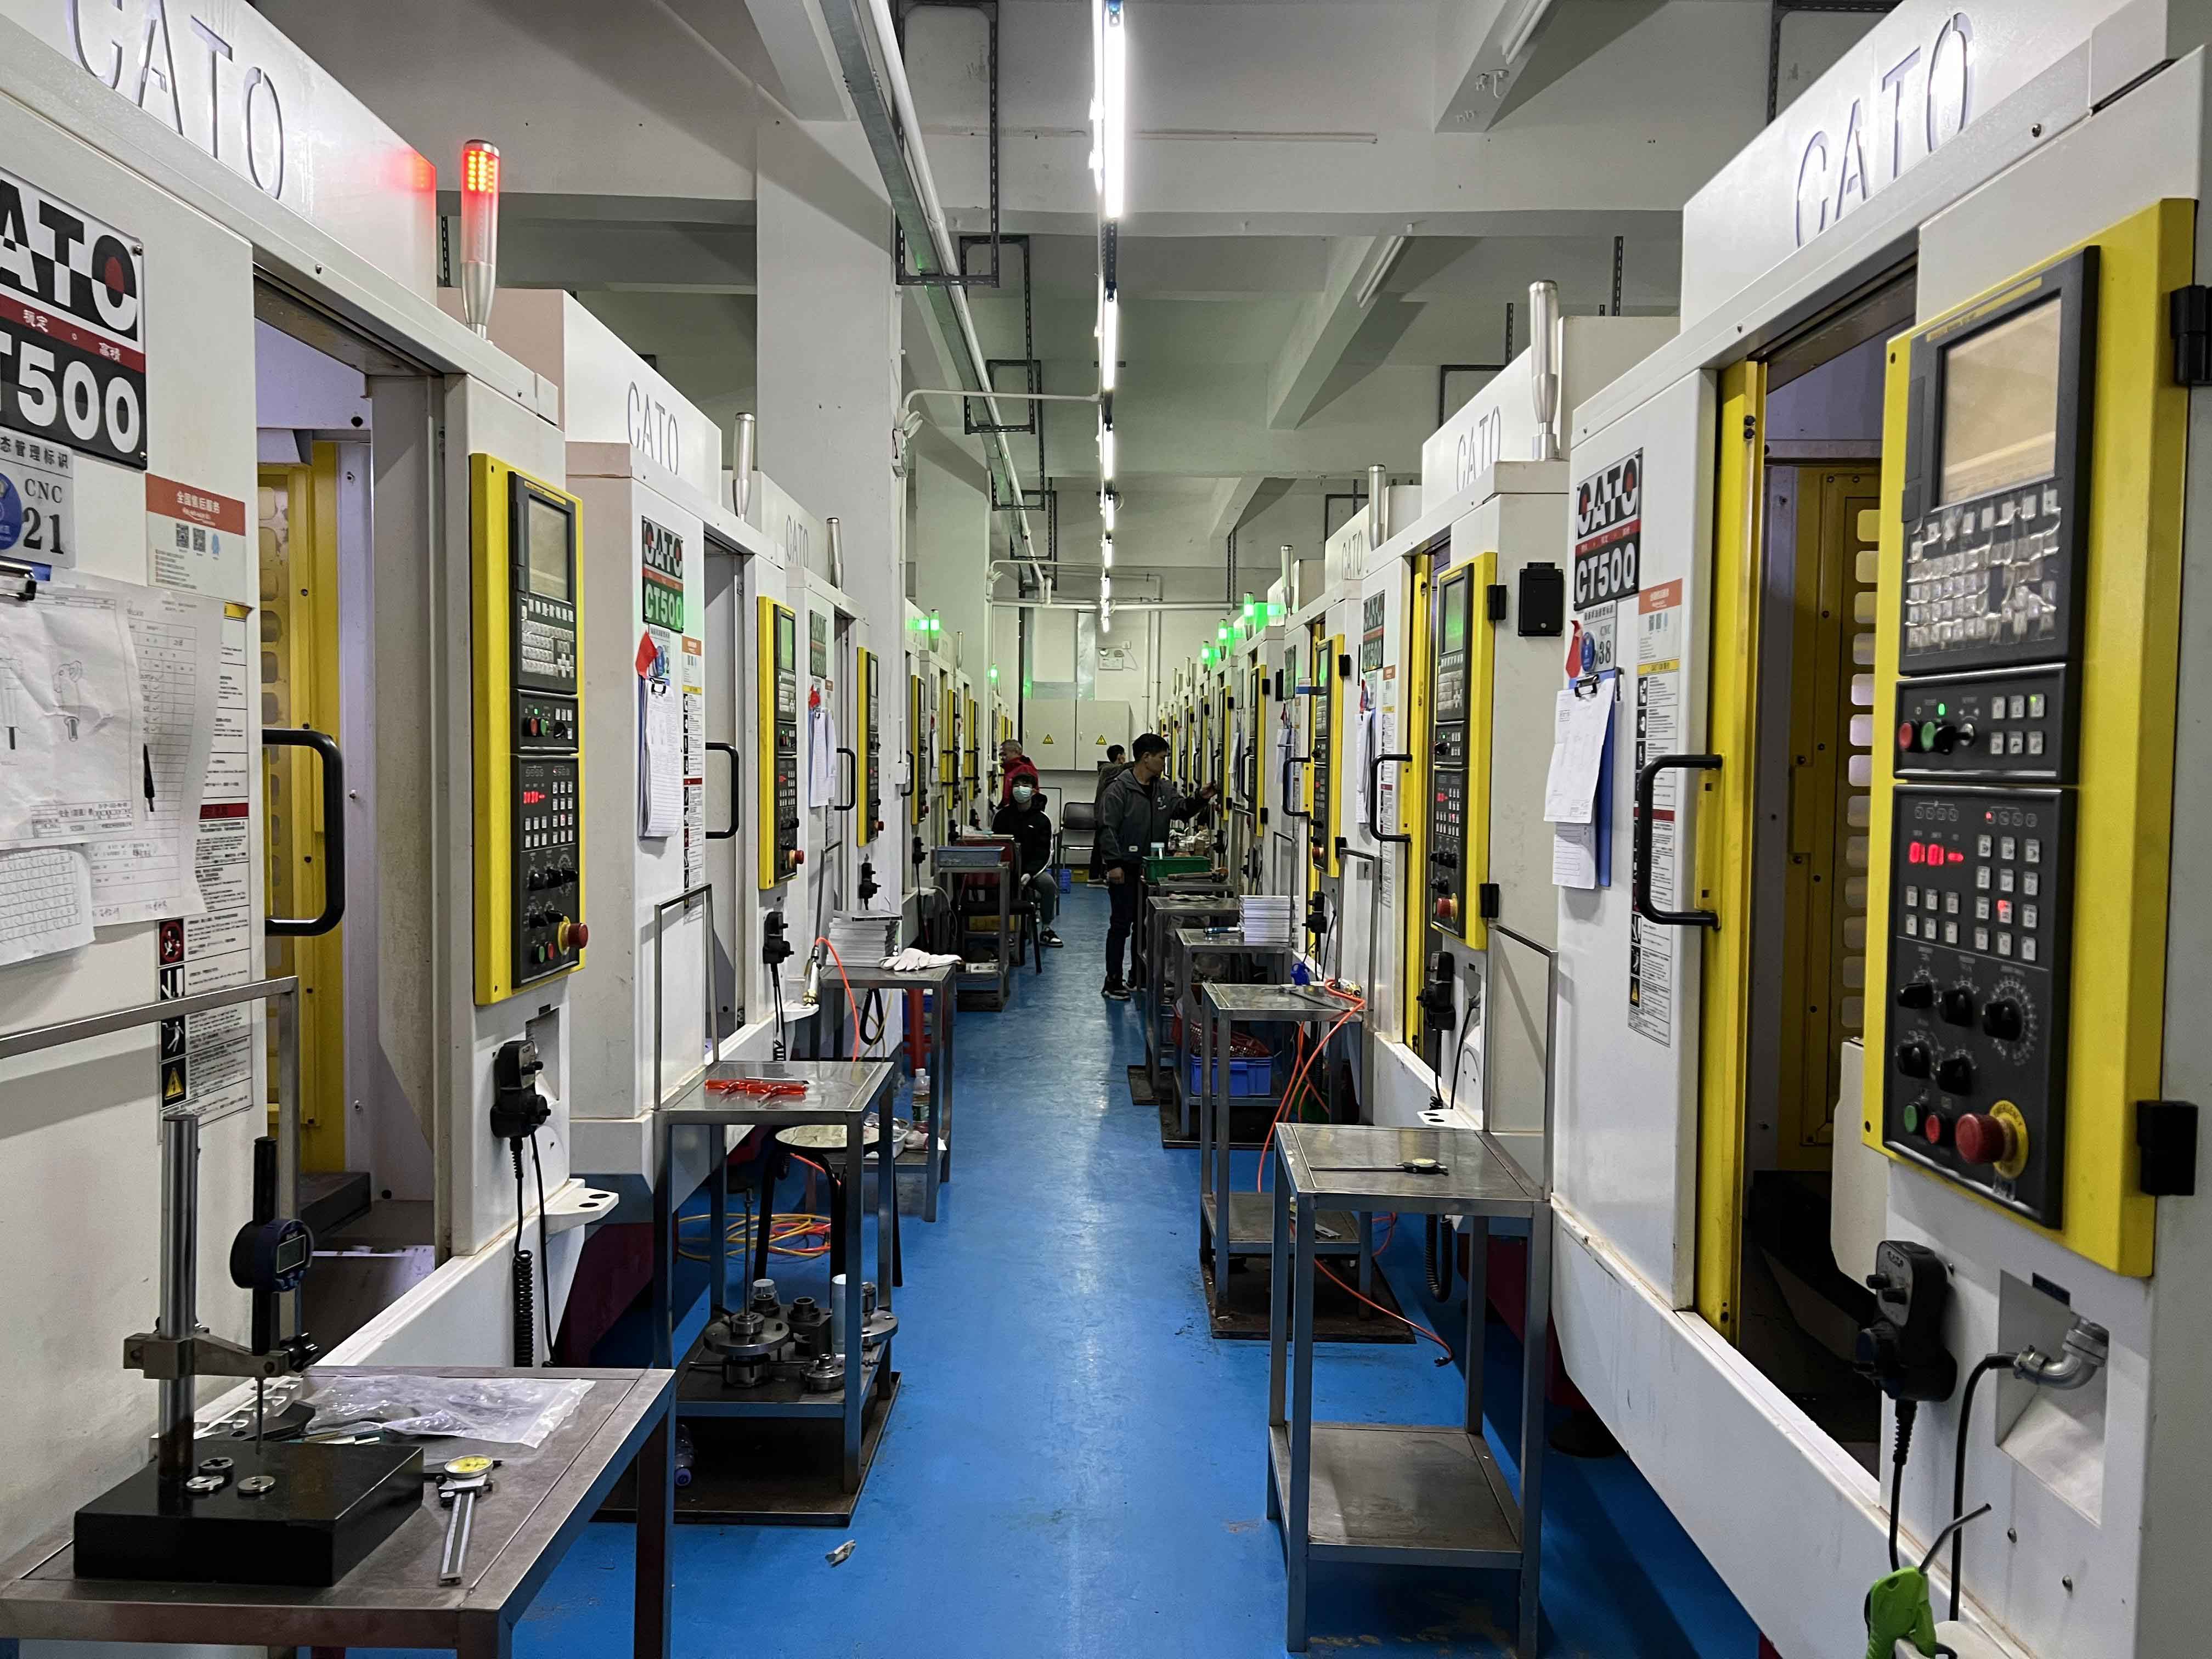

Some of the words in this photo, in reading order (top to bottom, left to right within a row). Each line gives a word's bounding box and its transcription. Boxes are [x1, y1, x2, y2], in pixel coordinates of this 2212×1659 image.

[65, 0, 284, 200] CATO
[1796, 12, 1975, 249] CATO
[628, 381, 679, 475] CATO
[1457, 405, 1501, 492] CATO
[25, 478, 62, 504] CNC
[1577, 458, 1638, 535] CATO
[22, 507, 64, 555] 21
[644, 522, 683, 577] CATO
[786, 514, 809, 568] CATO
[1576, 542, 1636, 603] CT500
[645, 584, 683, 629] CT500
[1599, 640, 1611, 664] 38
